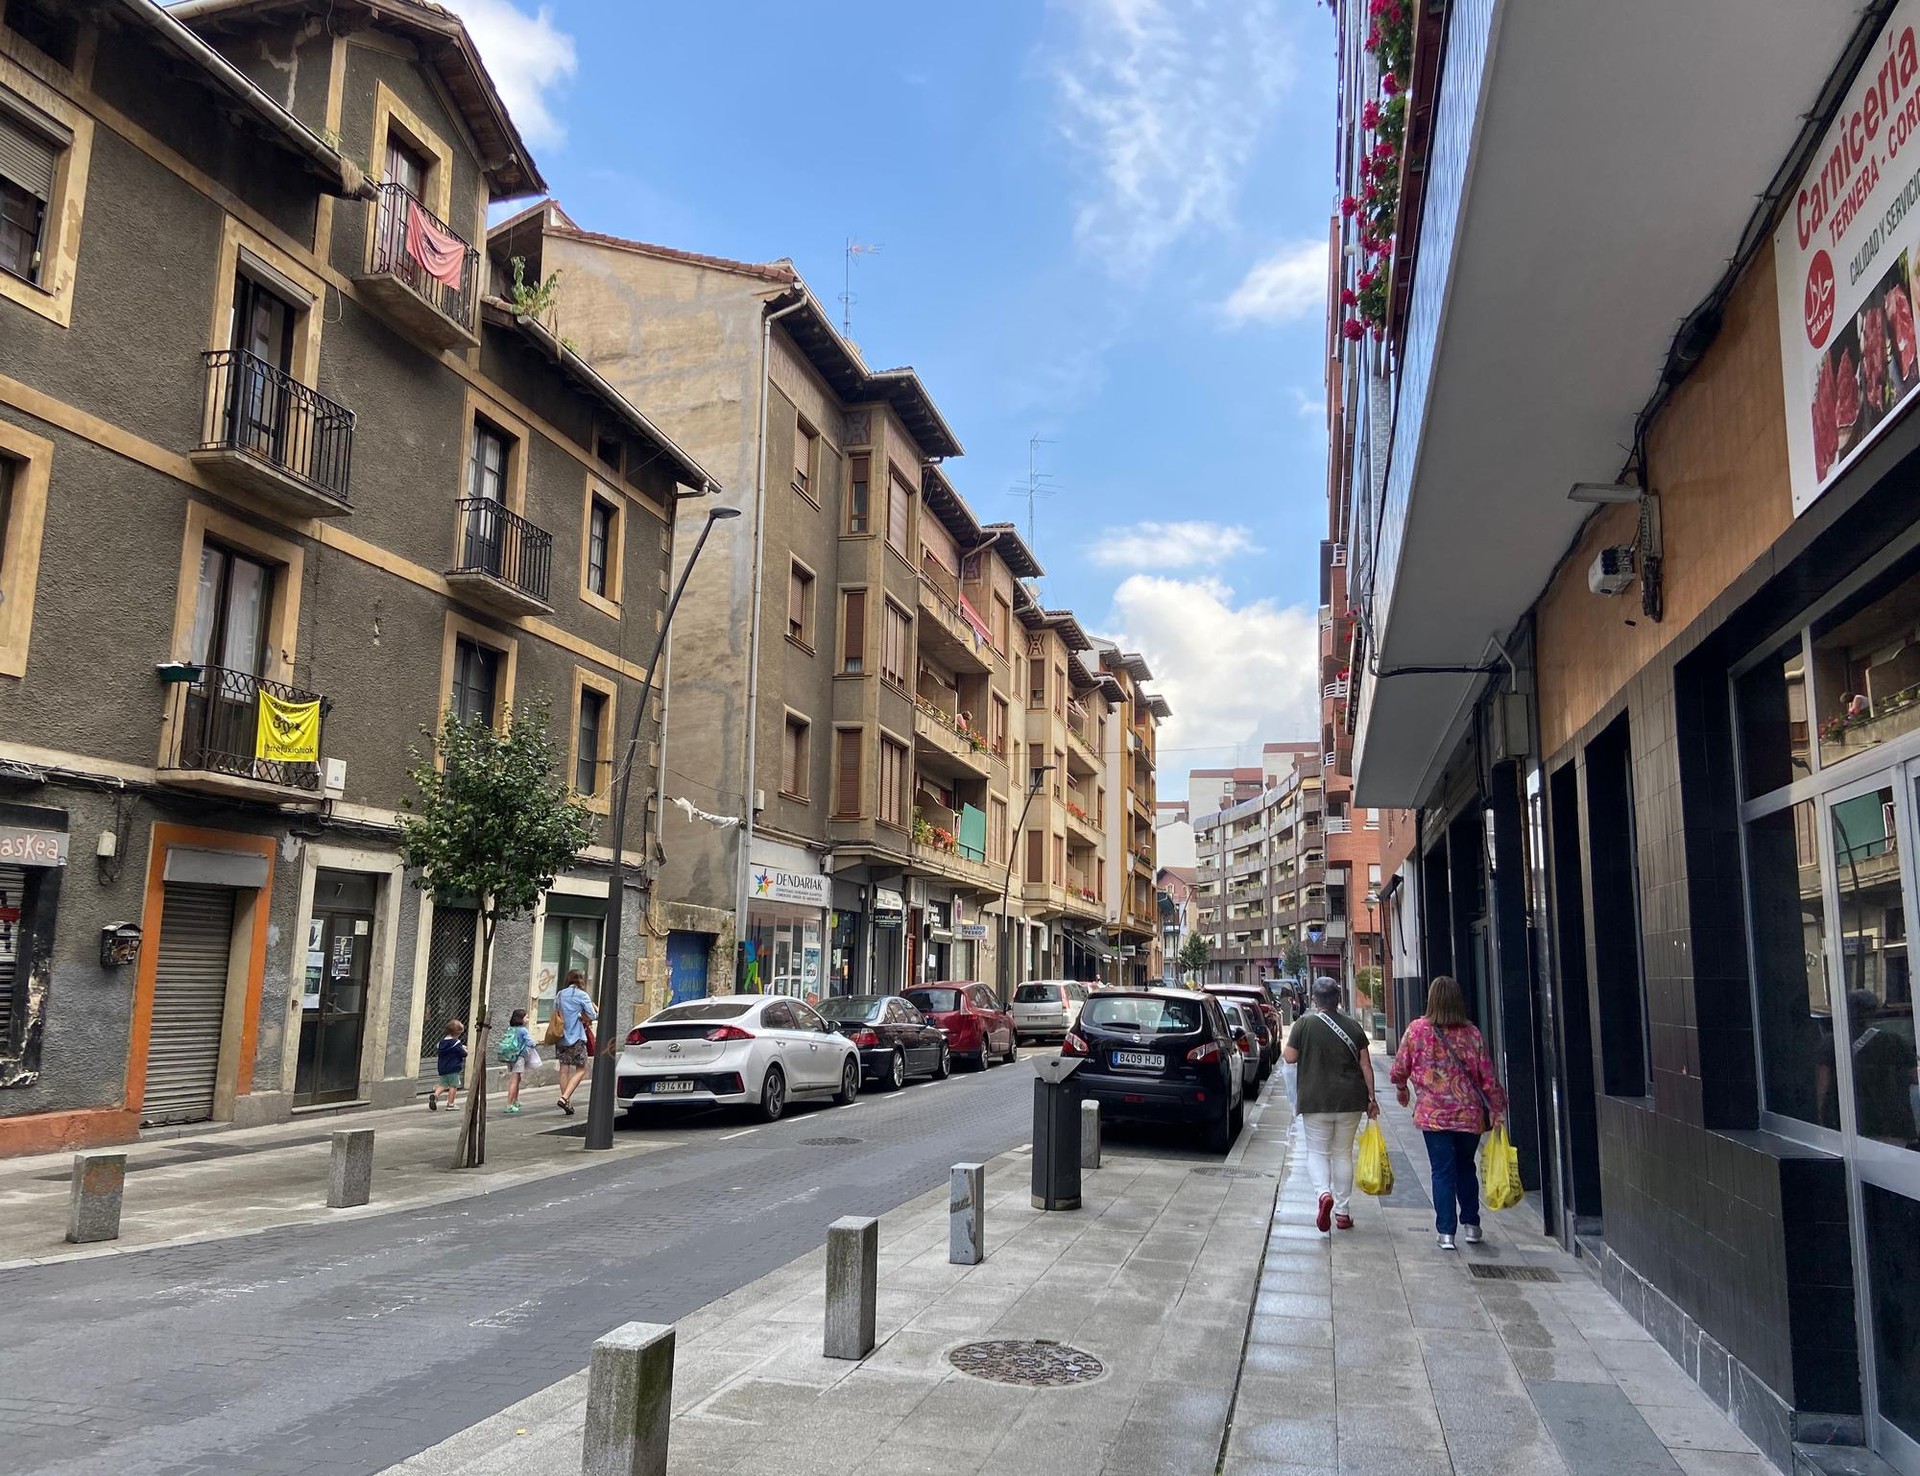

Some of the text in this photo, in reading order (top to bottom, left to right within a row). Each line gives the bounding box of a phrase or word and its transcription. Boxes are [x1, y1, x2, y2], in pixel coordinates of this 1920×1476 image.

[1797, 26, 1918, 251] Carnicería
[1829, 155, 1880, 248] TERNERA
[1849, 228, 1880, 286] CALIDAD
[1879, 217, 1885, 245] Y
[335, 883, 343, 897] 7
[776, 872, 823, 891] DENDARIAK
[1119, 1053, 1162, 1065] 8409 HJG
[656, 1083, 676, 1091] 9914
